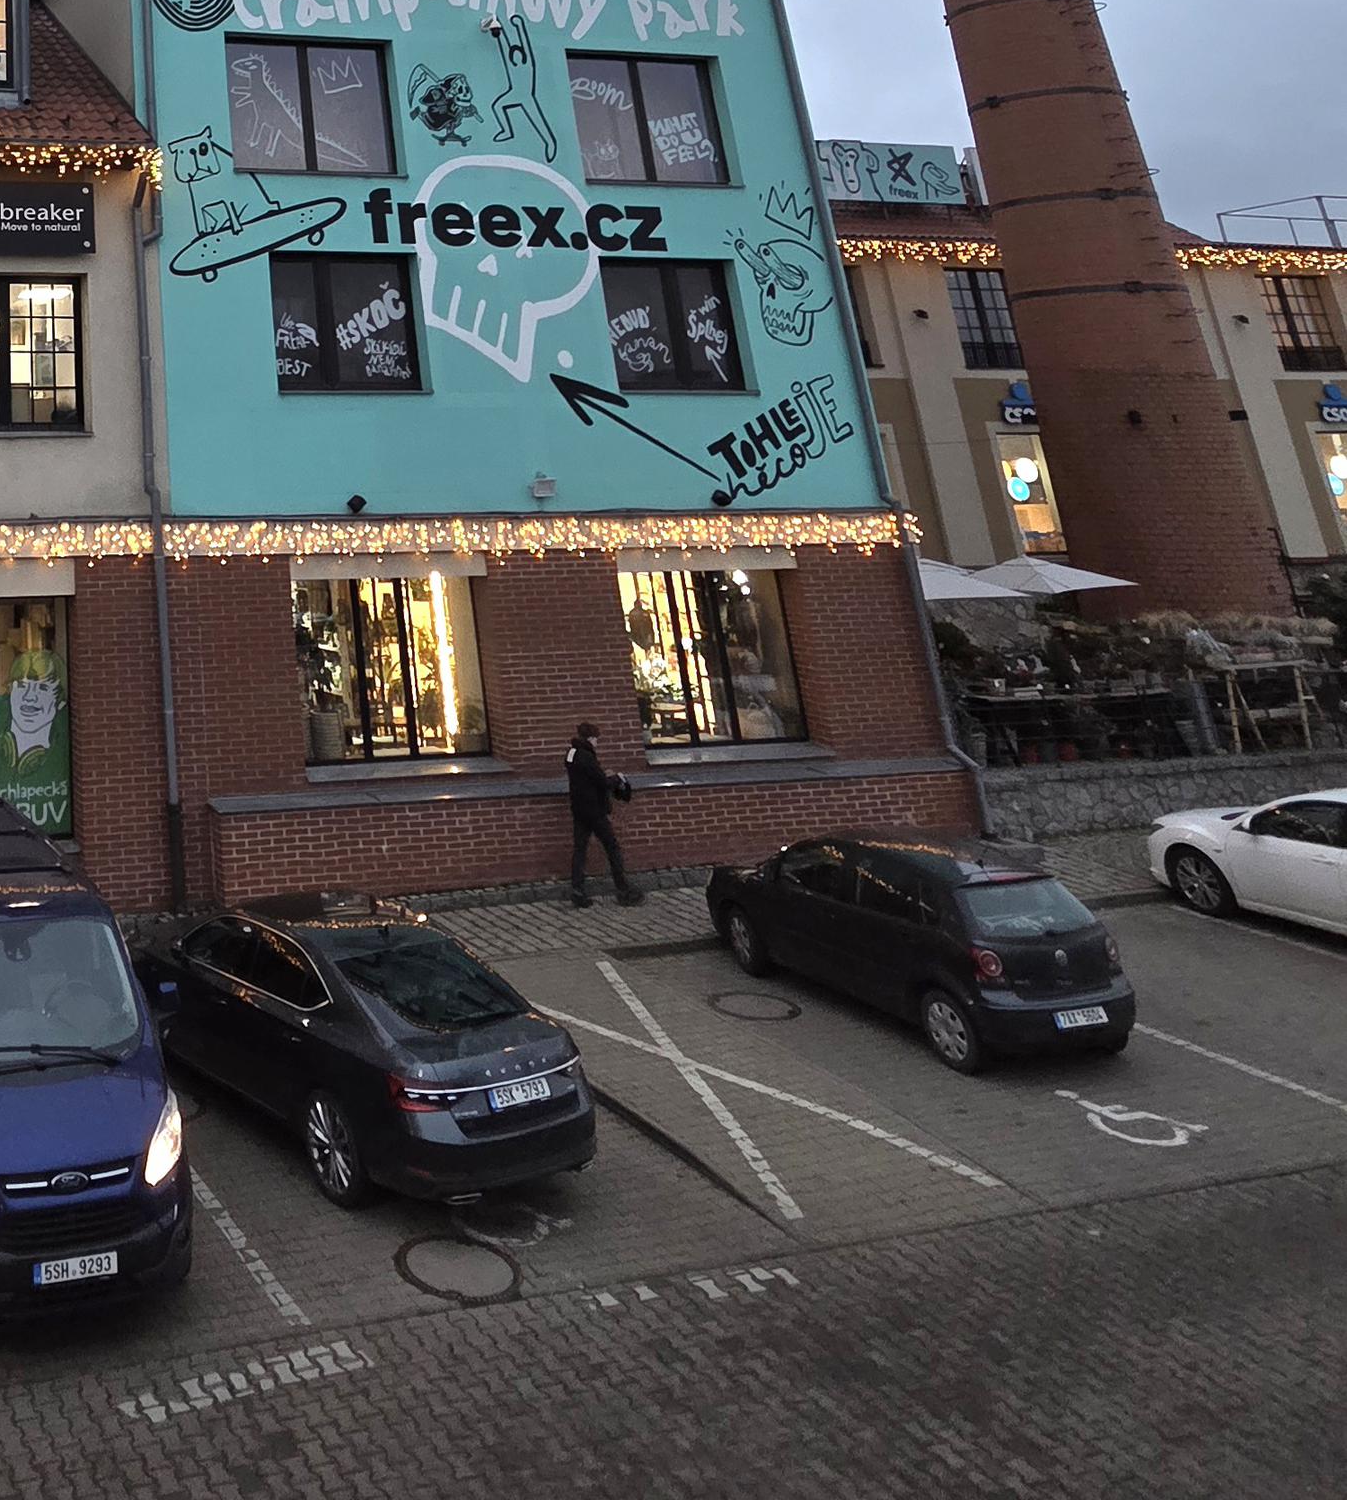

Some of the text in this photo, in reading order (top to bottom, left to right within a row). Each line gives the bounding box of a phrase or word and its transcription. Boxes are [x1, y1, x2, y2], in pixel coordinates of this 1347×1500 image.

[648, 112, 699, 136] WHAT
[655, 129, 703, 151] DO U
[662, 138, 719, 166] FEEL?
[888, 184, 919, 200] freex
[1, 222, 81, 232] Move to natural
[364, 188, 668, 252] freex.cz
[275, 358, 313, 378] BEST
[0, 780, 69, 801] chlapecká
[15, 800, 68, 827] BUV
[520, 1080, 546, 1100] 5793
[44, 1256, 112, 1280] 5SH 9293
